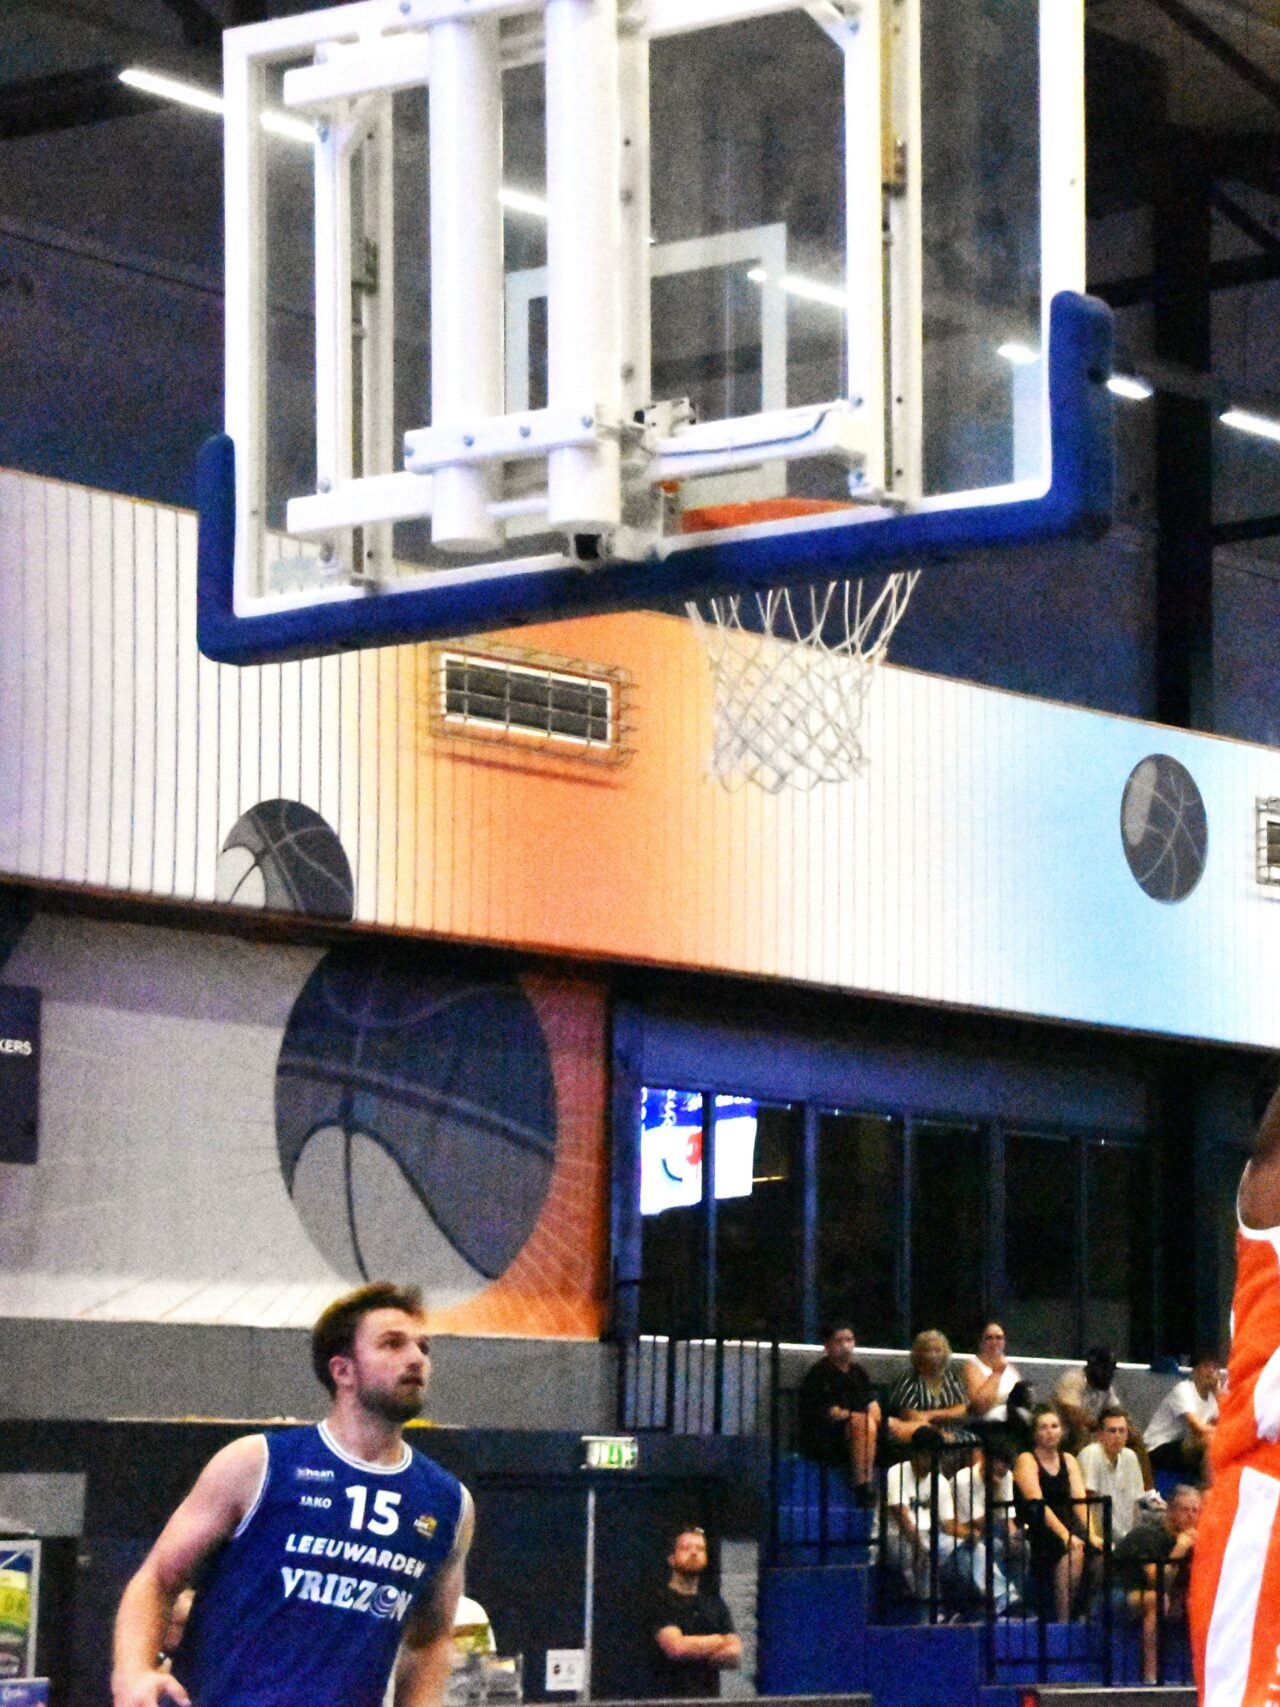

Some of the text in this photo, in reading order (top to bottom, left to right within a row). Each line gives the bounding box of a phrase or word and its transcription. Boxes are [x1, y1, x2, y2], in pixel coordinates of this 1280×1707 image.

[345, 1485, 401, 1535] 15
[285, 1533, 426, 1578] LEEUWARDEN
[281, 1566, 412, 1621] VRIEZON
